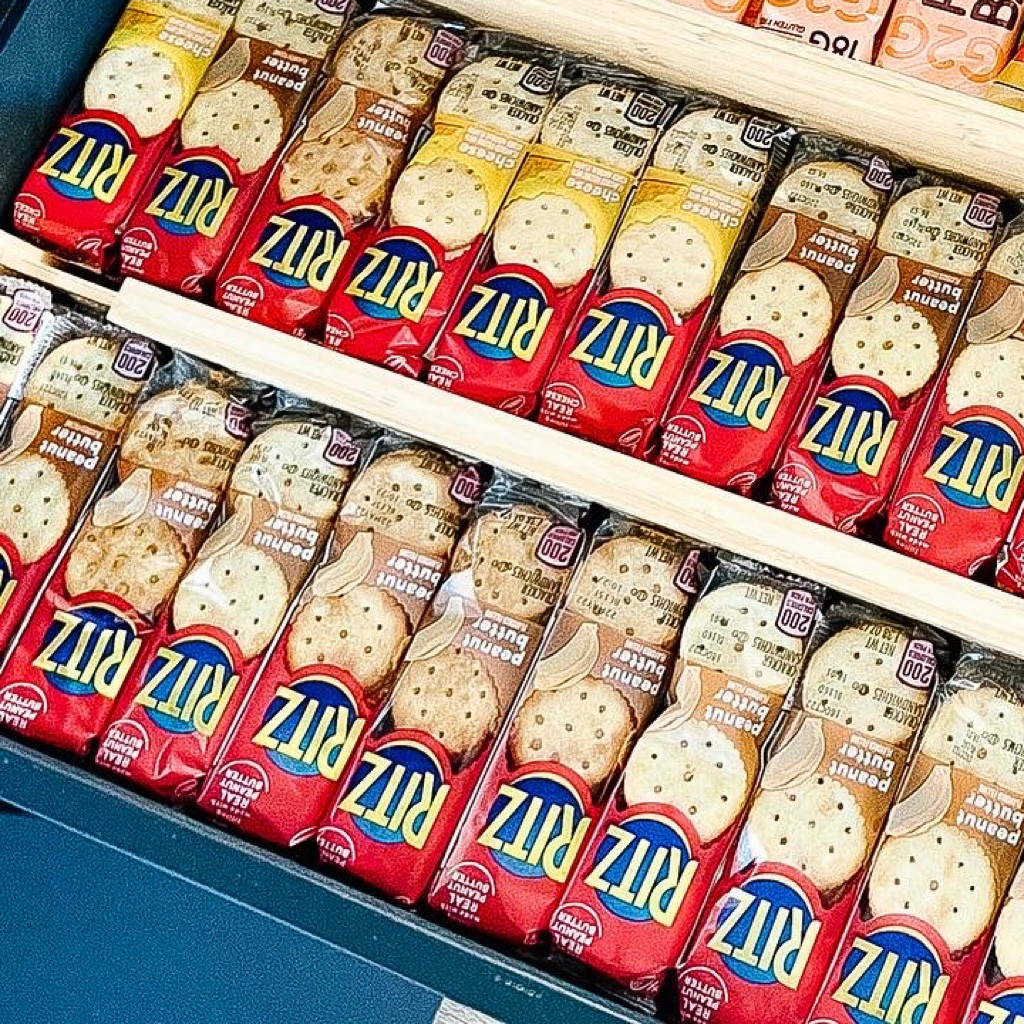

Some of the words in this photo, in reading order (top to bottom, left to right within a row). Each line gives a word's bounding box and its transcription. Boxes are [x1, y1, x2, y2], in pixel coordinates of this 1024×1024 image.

[160, 32, 211, 58] cheese
[885, 16, 1002, 82] G2G
[252, 68, 307, 93] peanut
[261, 54, 311, 78] butter
[525, 72, 555, 92] 200
[632, 102, 658, 123] 200
[746, 125, 772, 146] 200
[37, 127, 137, 204] RITZ
[459, 140, 516, 170] cheese
[566, 176, 621, 204] cheese
[870, 167, 893, 187] 200
[145, 164, 240, 238] RITZ
[682, 199, 739, 229] cheese
[967, 207, 998, 226] 200
[249, 214, 351, 293] RITZ
[799, 249, 857, 273] peanut
[808, 234, 861, 258] butter
[345, 246, 445, 324] RITZ
[911, 275, 963, 301] butter
[902, 288, 961, 315] peanut
[452, 284, 554, 362] RITZ
[116, 352, 148, 377] 200
[569, 309, 675, 391] RITZ
[690, 350, 790, 433] RITZ
[50, 425, 103, 455] butter
[798, 396, 899, 478] RITZ
[38, 438, 96, 471] peanut
[328, 443, 356, 462] 200
[262, 516, 320, 545] butter
[253, 531, 314, 561] peanut
[542, 537, 571, 560] 200
[471, 616, 530, 648] butter
[781, 613, 809, 635] 200
[35, 611, 142, 700] RITZ
[461, 630, 524, 665] peanut
[610, 648, 667, 678] butter
[900, 660, 932, 681] 200
[134, 646, 240, 739] RITZ
[601, 664, 660, 695] peanut
[713, 689, 770, 719] butter
[252, 685, 366, 783] RITZ
[704, 705, 763, 736] peanut
[838, 744, 895, 776] butter
[829, 761, 892, 794] peanut
[338, 751, 451, 850] RITZ
[965, 795, 1024, 825] butter
[477, 783, 592, 884] RITZ
[956, 811, 1020, 846] peanut
[584, 824, 699, 927] RITZ
[707, 888, 822, 990] RITZ
[832, 938, 951, 1024] RITZ
